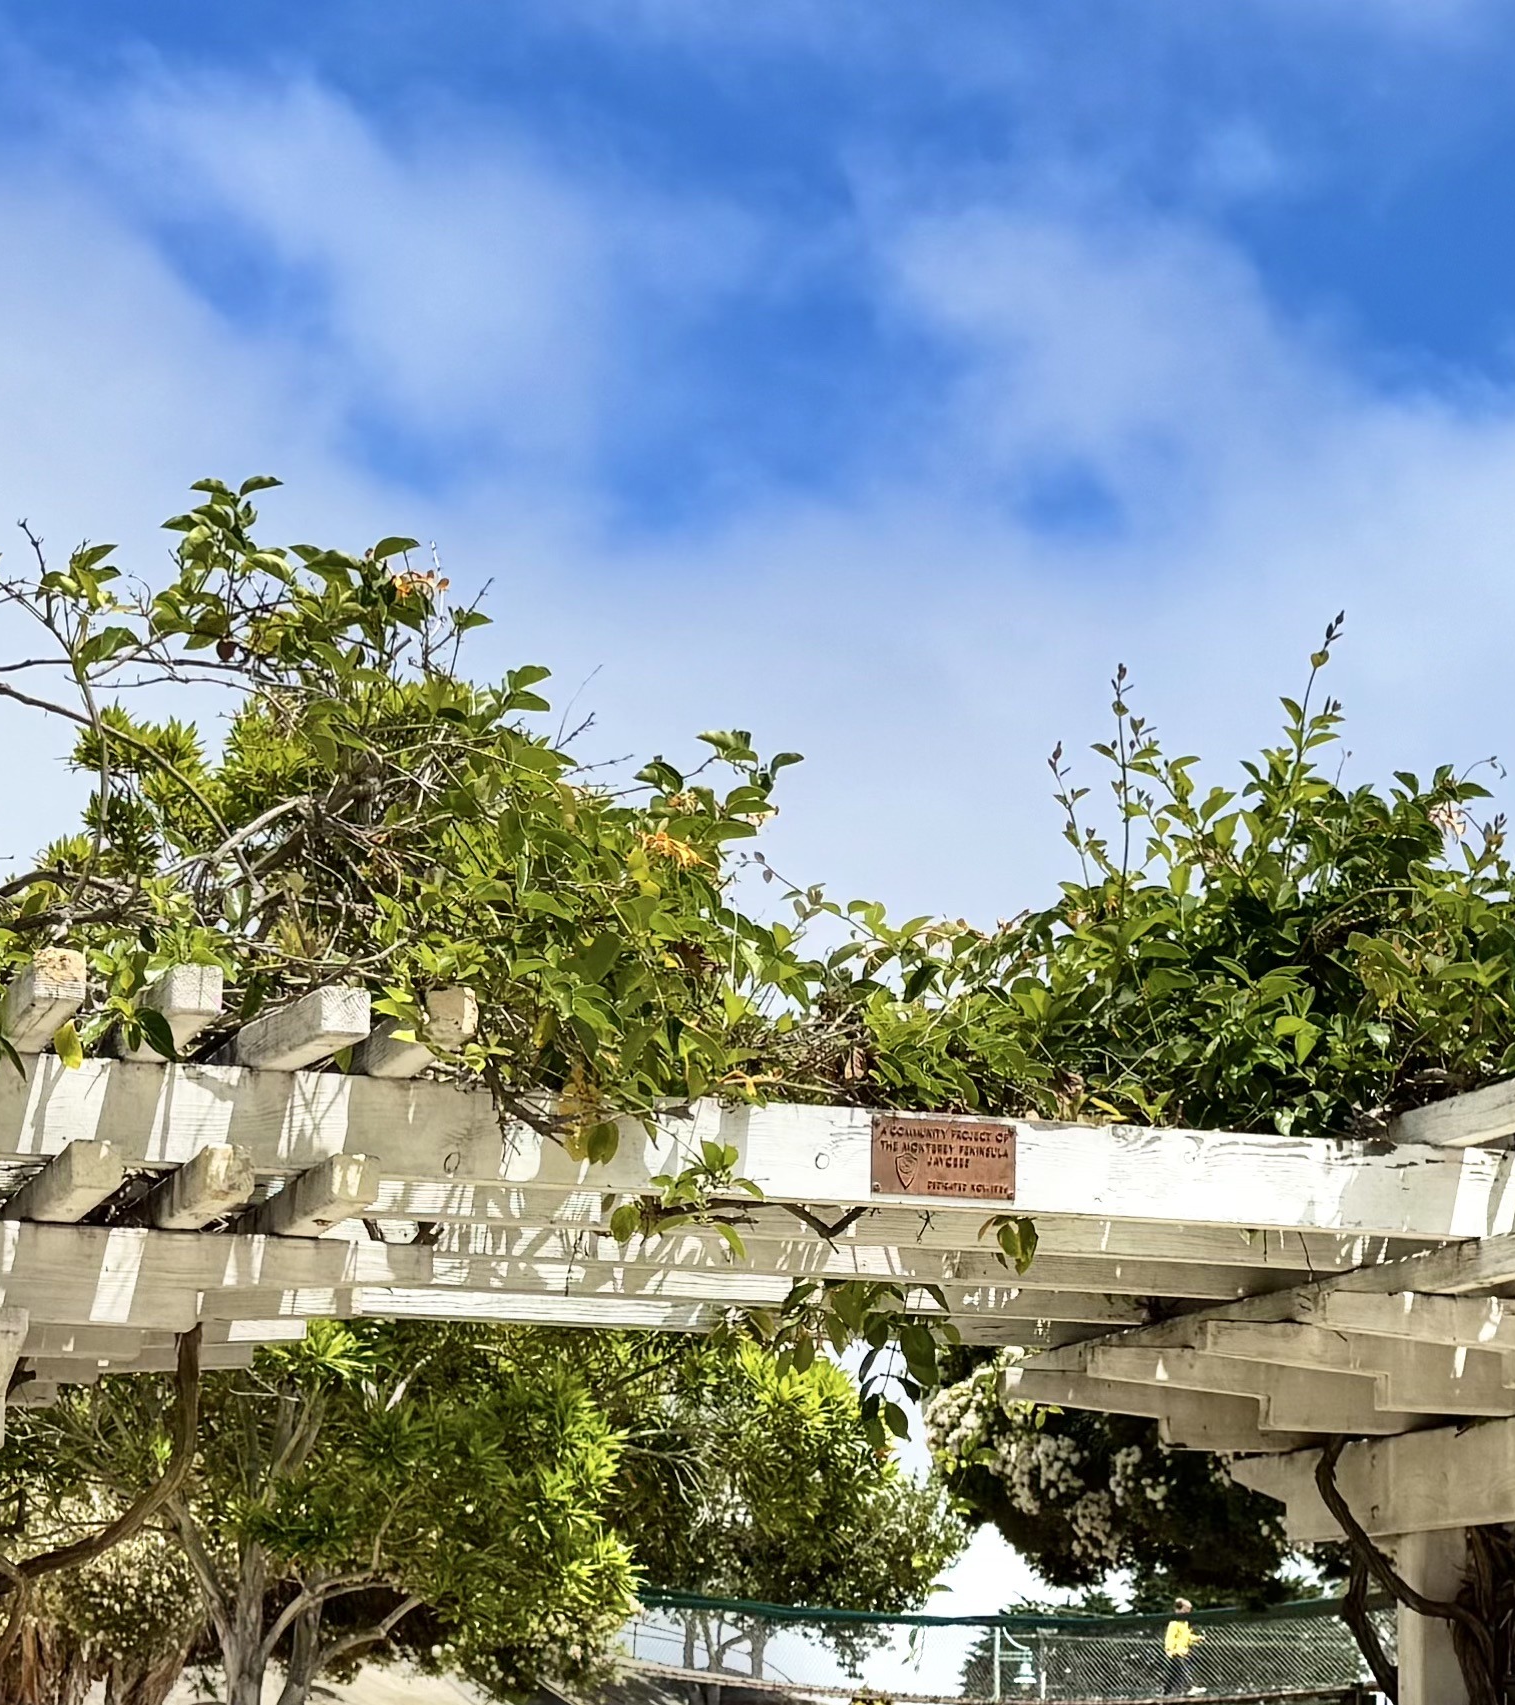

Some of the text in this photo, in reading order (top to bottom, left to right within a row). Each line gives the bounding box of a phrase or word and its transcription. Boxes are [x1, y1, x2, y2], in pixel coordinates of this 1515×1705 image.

[890, 1126, 946, 1140] COMMUNITY
[951, 1129, 992, 1142] PROJECT
[881, 1140, 898, 1152] THE
[903, 1142, 953, 1155] MONTEREY
